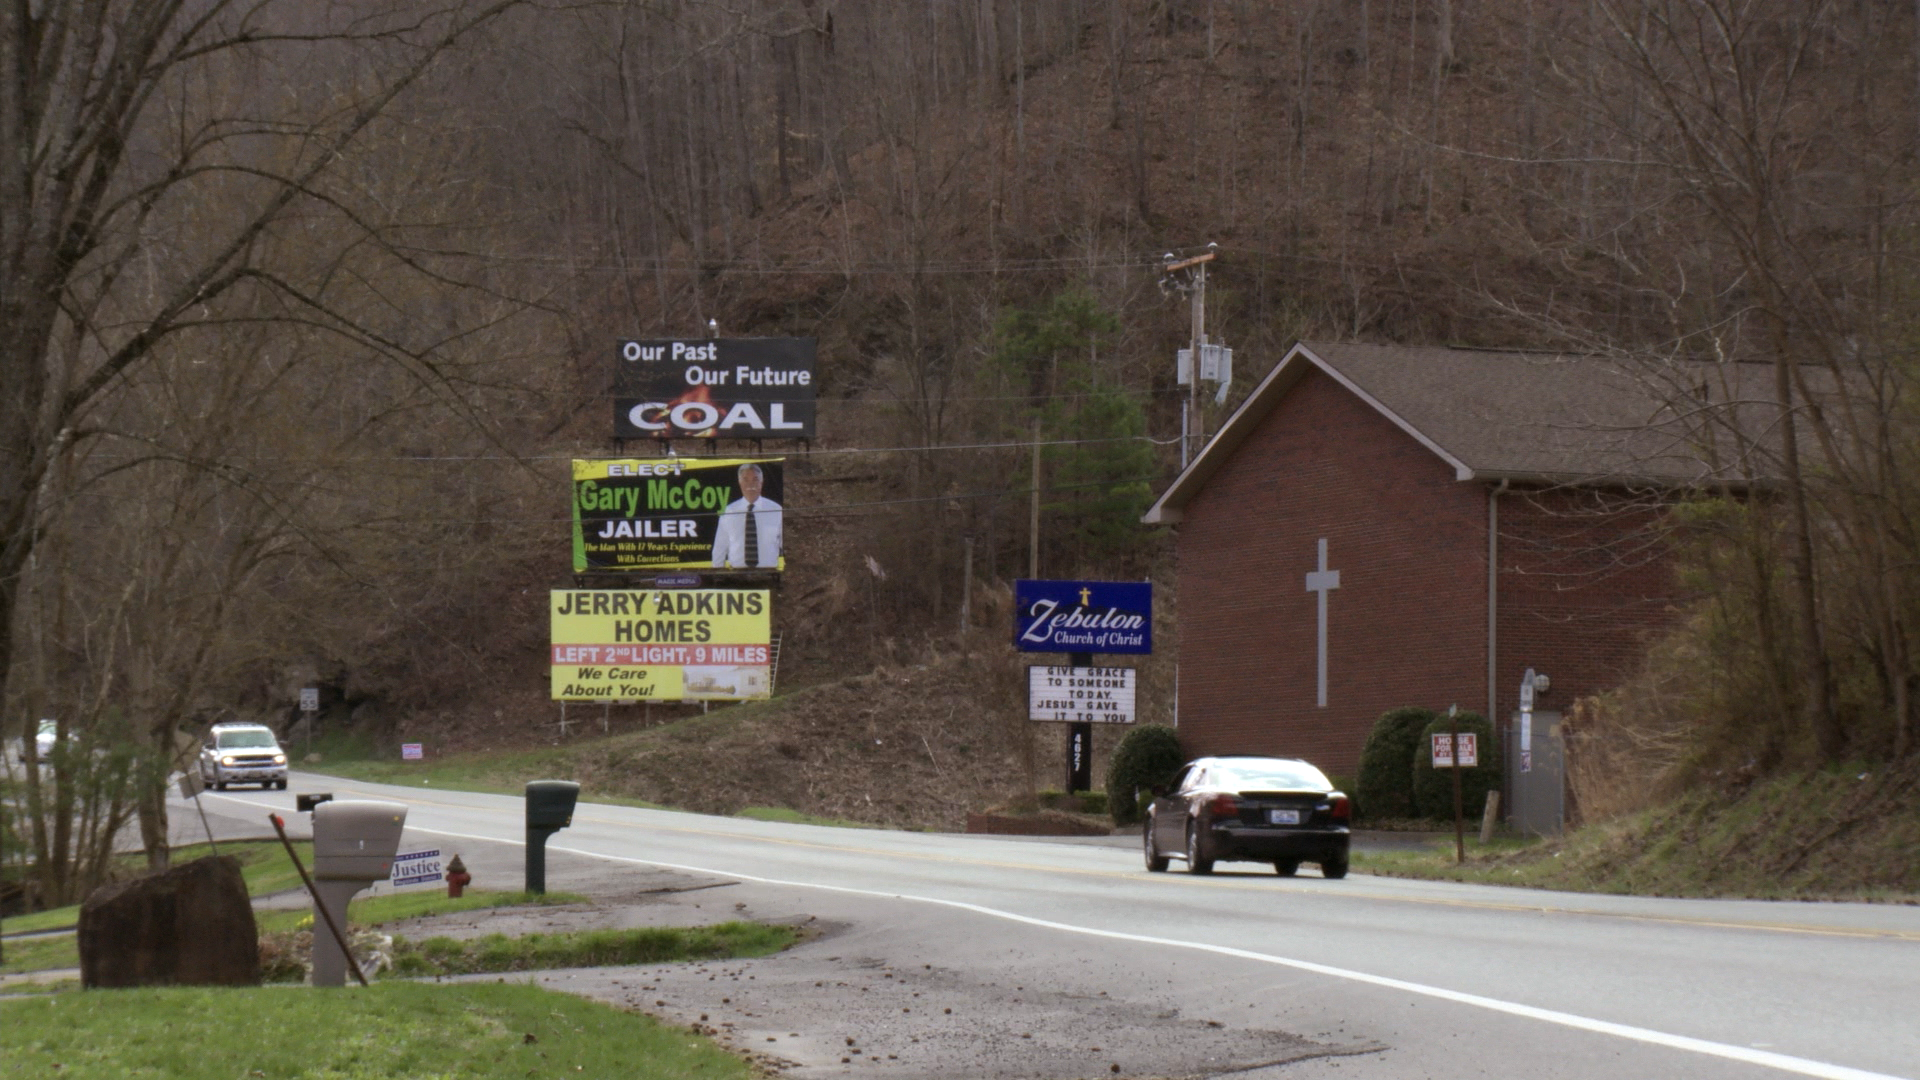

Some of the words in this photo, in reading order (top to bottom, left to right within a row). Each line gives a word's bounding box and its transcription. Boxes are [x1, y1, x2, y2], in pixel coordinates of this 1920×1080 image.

[623, 342, 665, 361] Our
[672, 342, 717, 361] Past
[685, 366, 729, 385] Our
[736, 366, 811, 385] Future
[628, 402, 803, 430] COAL
[608, 464, 685, 476] ELECT
[581, 480, 640, 518] Gary
[648, 479, 731, 516] McCoy
[598, 520, 698, 538] JAILER
[584, 543, 598, 552] The
[600, 543, 616, 552] Man
[618, 542, 636, 551] With
[638, 542, 646, 551] 17
[647, 542, 668, 551] Years
[670, 542, 712, 553] Experience
[617, 554, 635, 563] With
[637, 554, 680, 563] Corrections
[558, 592, 647, 615] JERRY
[657, 592, 763, 615] ADKINS
[1020, 599, 1146, 643] Zebulon
[615, 620, 711, 642] HOMES
[1054, 631, 1093, 644] Church
[1096, 632, 1108, 647] of
[1109, 631, 1143, 646] Christ
[555, 647, 602, 663] LEFT
[632, 647, 691, 665] LIGHT,
[695, 647, 706, 663] 9
[712, 647, 767, 663] MILES
[577, 668, 602, 680] We
[608, 667, 647, 680] Care
[1047, 667, 1075, 676] GIVE
[1087, 668, 1126, 677] GRACE
[561, 684, 612, 697] About
[619, 684, 655, 697] You!
[1048, 678, 1062, 686] TO
[1068, 679, 1126, 688] SOMEONE
[1037, 700, 1075, 709] JESUS
[1087, 702, 1118, 710] GAVE
[1055, 712, 1066, 720] IT
[1077, 713, 1093, 721] TO
[1104, 713, 1126, 722] YOU
[1438, 737, 1470, 745] HOSE
[392, 860, 441, 878] Justice
